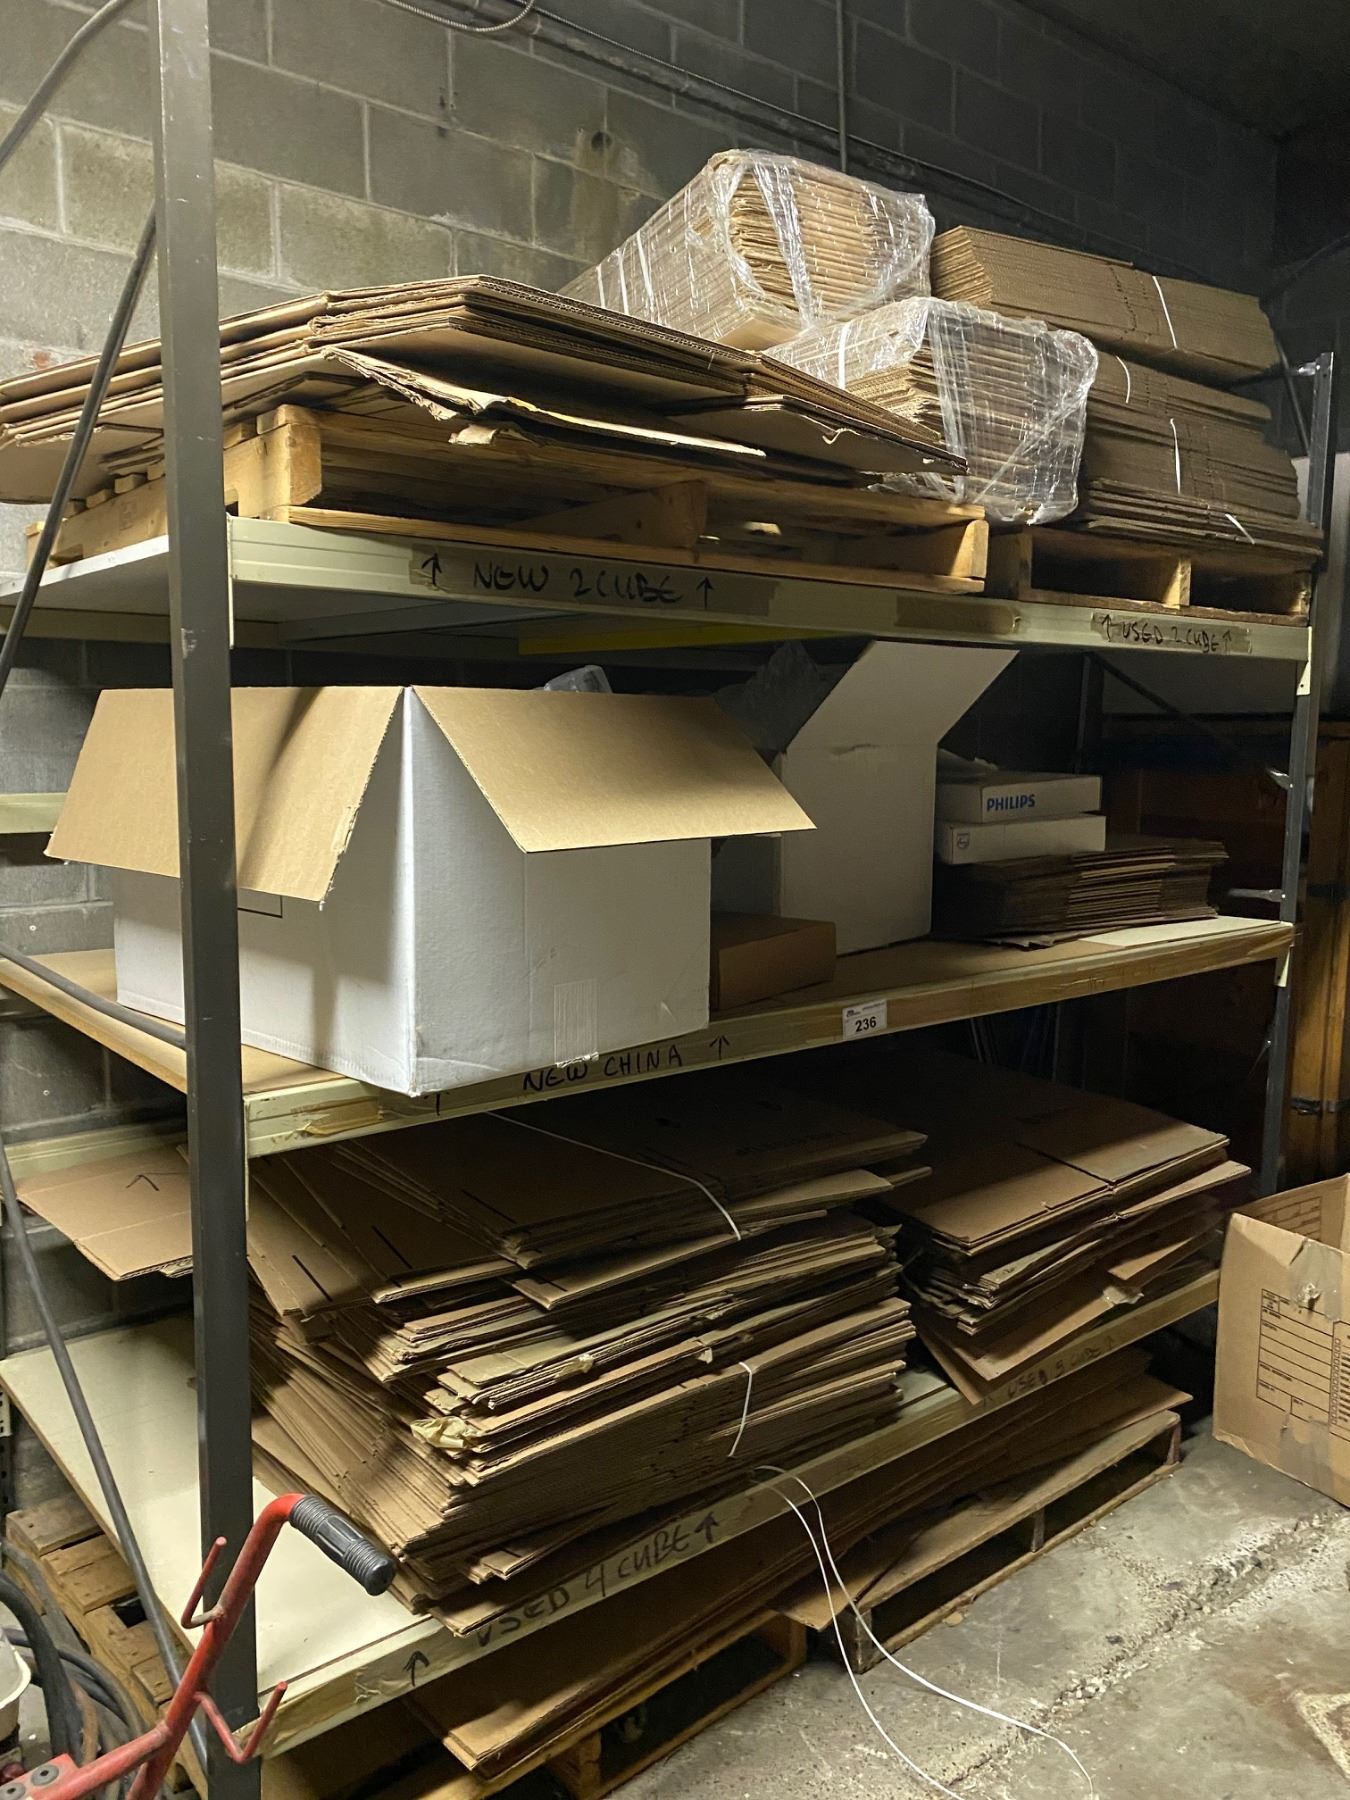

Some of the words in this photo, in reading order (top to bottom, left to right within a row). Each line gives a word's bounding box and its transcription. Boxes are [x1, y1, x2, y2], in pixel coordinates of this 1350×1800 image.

[473, 561, 549, 592] NEW
[1121, 620, 1164, 645] USED
[986, 793, 1036, 812] PHILIPS
[855, 1016, 877, 1033] 236
[522, 1063, 588, 1091] NEW
[604, 1045, 684, 1077] CHINA
[585, 1563, 606, 1598] 4
[617, 1523, 690, 1578] CUBE
